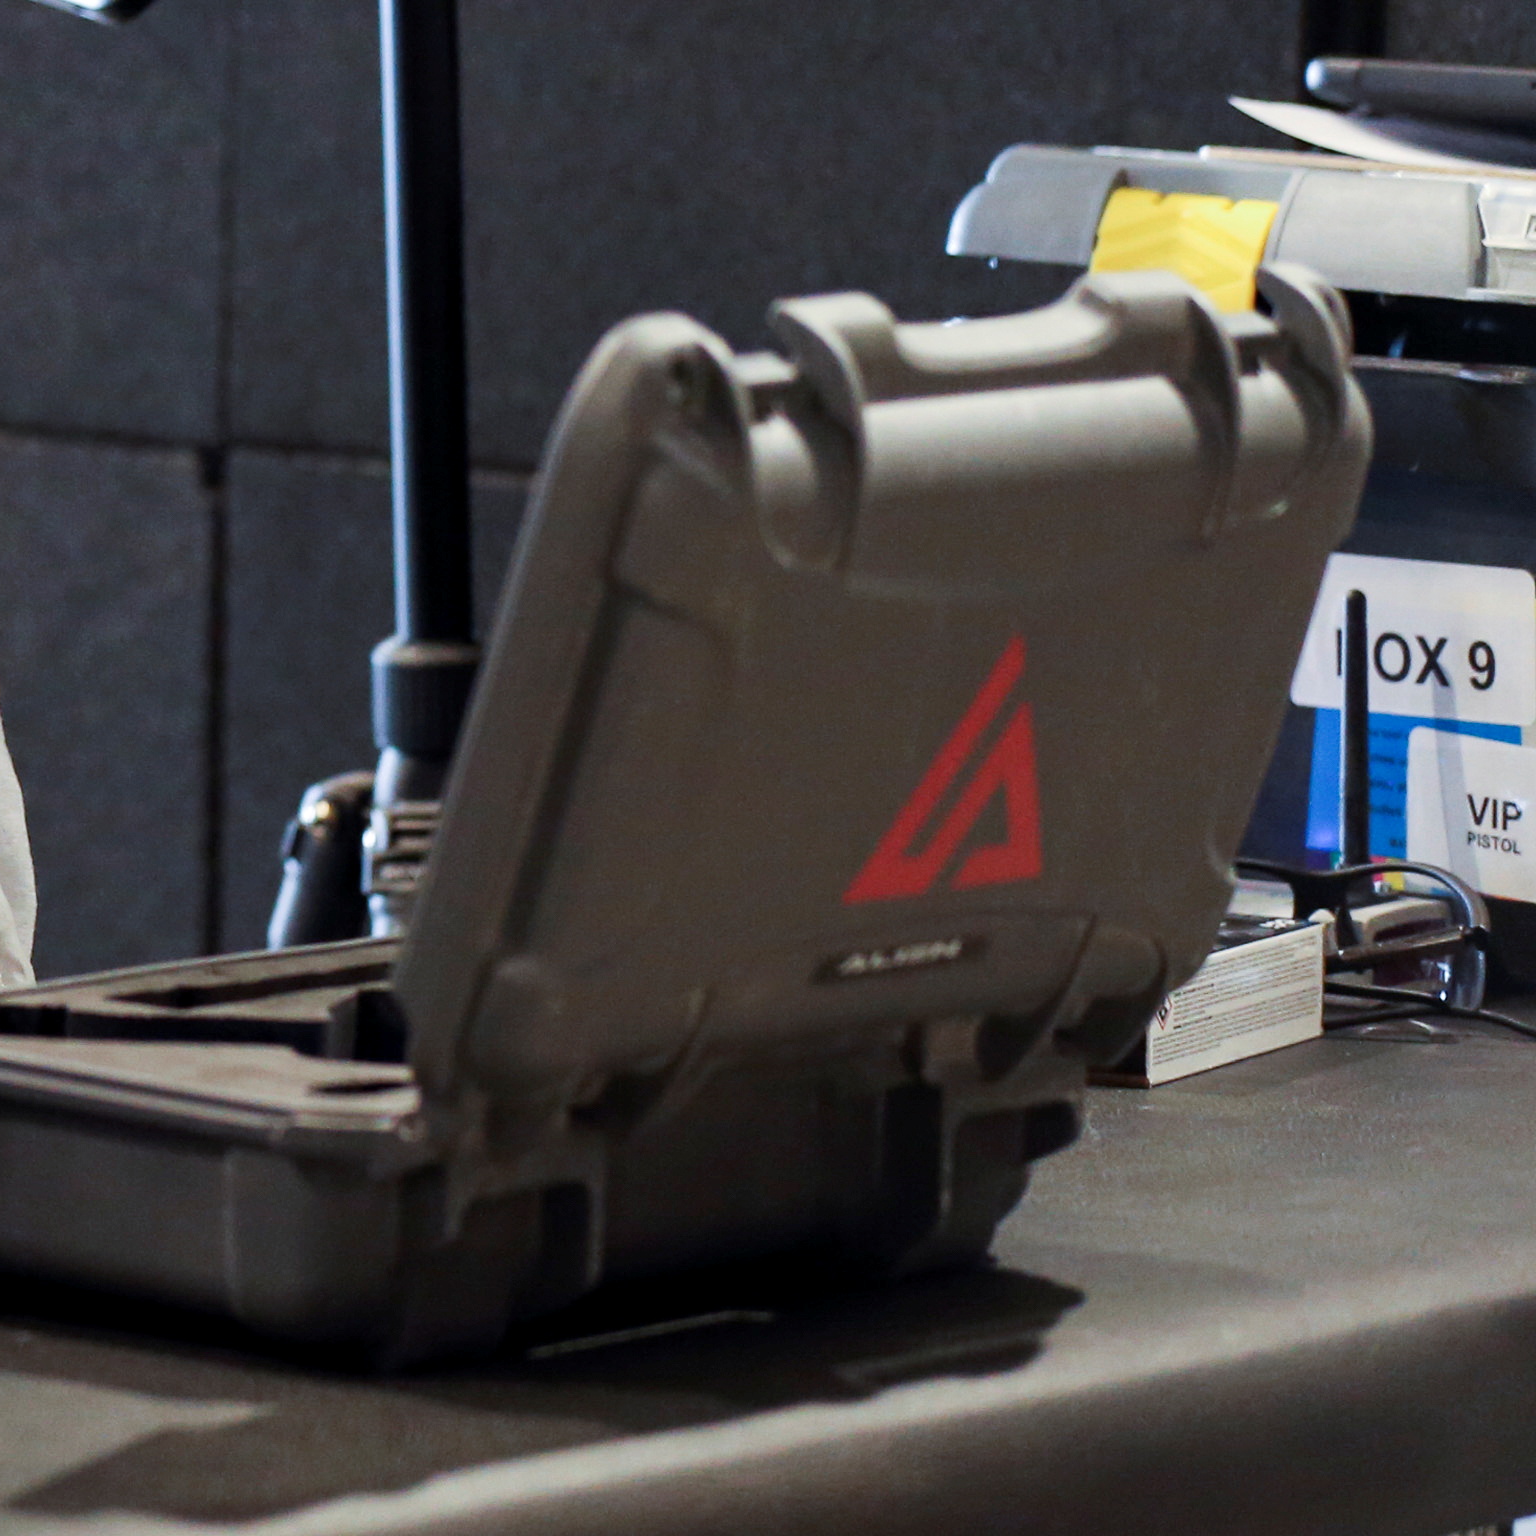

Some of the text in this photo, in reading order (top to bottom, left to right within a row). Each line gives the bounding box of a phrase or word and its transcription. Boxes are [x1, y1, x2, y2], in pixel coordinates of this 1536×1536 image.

[1336, 629, 1496, 690] OX 9
[1467, 794, 1522, 831] VIP
[1467, 831, 1521, 855] PISTOL
